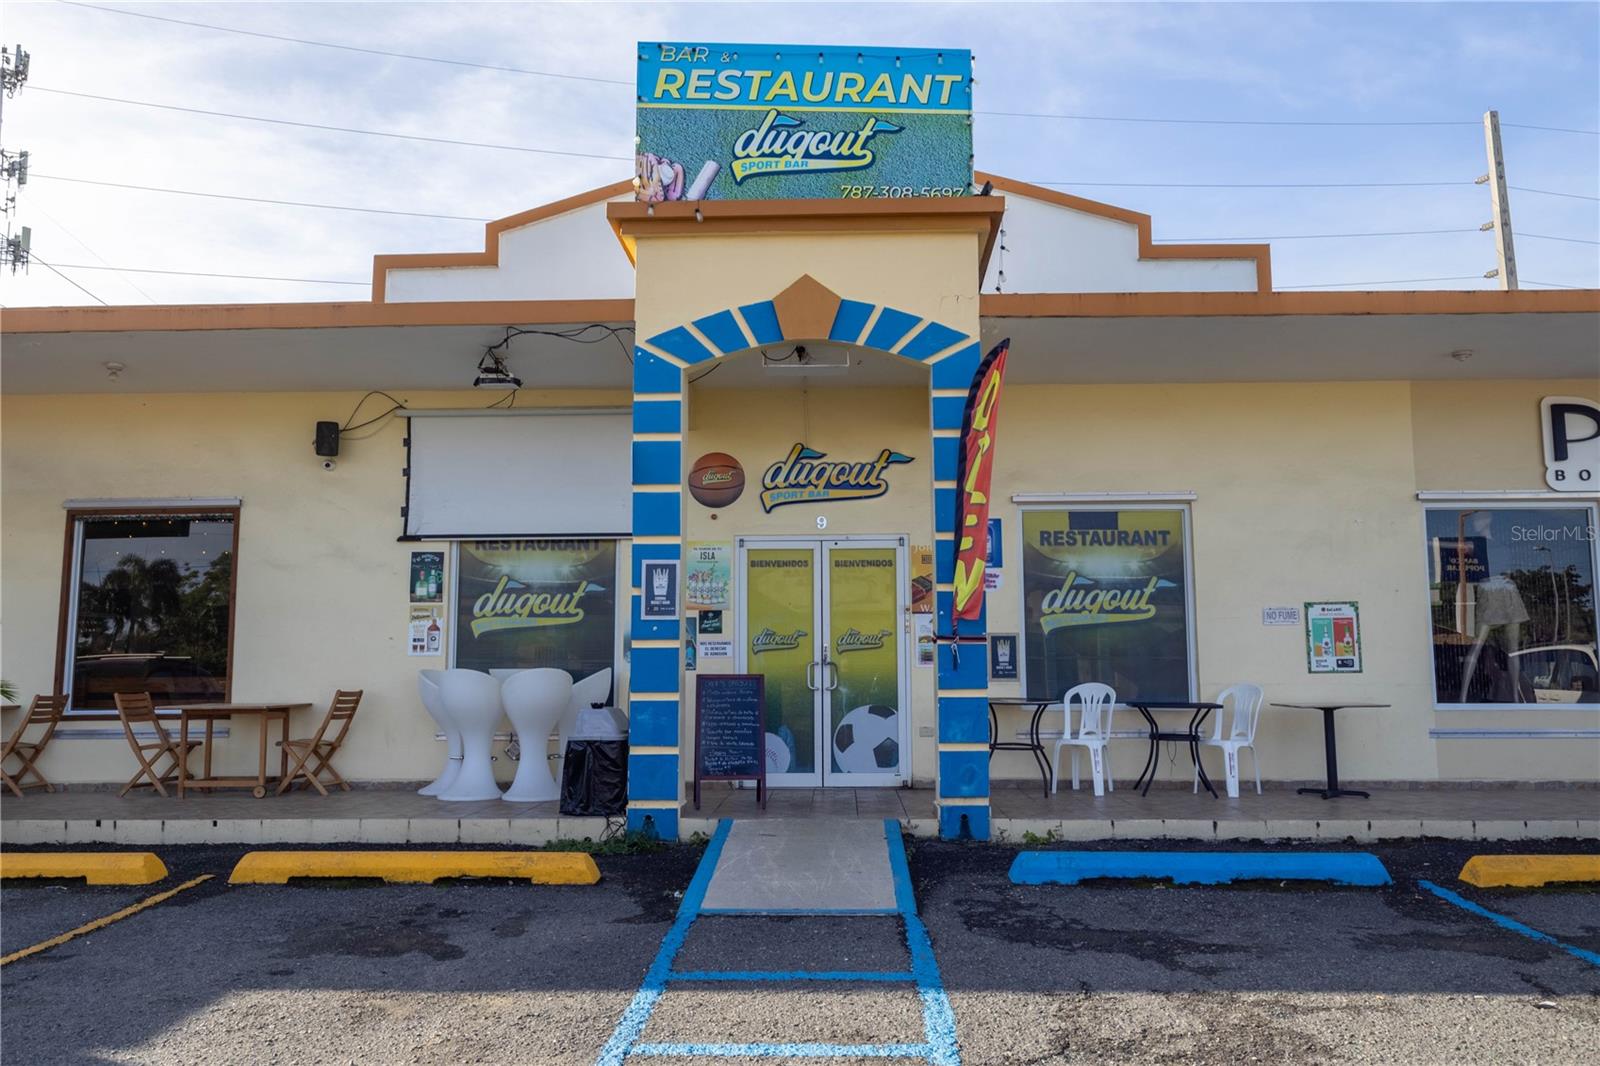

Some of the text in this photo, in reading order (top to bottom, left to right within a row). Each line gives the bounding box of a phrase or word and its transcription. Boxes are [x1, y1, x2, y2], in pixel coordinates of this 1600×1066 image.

[660, 46, 732, 63] BAR &
[653, 68, 963, 105] RESTAURANT
[733, 109, 876, 160] dugout
[740, 159, 809, 173] SPORT BAR
[840, 185, 964, 199] 787-308-5697
[763, 442, 891, 491] dugout
[769, 489, 830, 501] SPORT BAR
[816, 515, 828, 529] 9
[1040, 529, 1171, 547] RESTAURANT
[700, 551, 716, 560] ISLA
[750, 559, 809, 568] BIENVENIDOS
[834, 559, 893, 568] BIENVENIDOS
[473, 575, 588, 618] dugout
[1042, 571, 1157, 614] dugout
[1266, 610, 1298, 620] NO FUME
[753, 628, 799, 645] dugout
[837, 628, 883, 645] dugout
